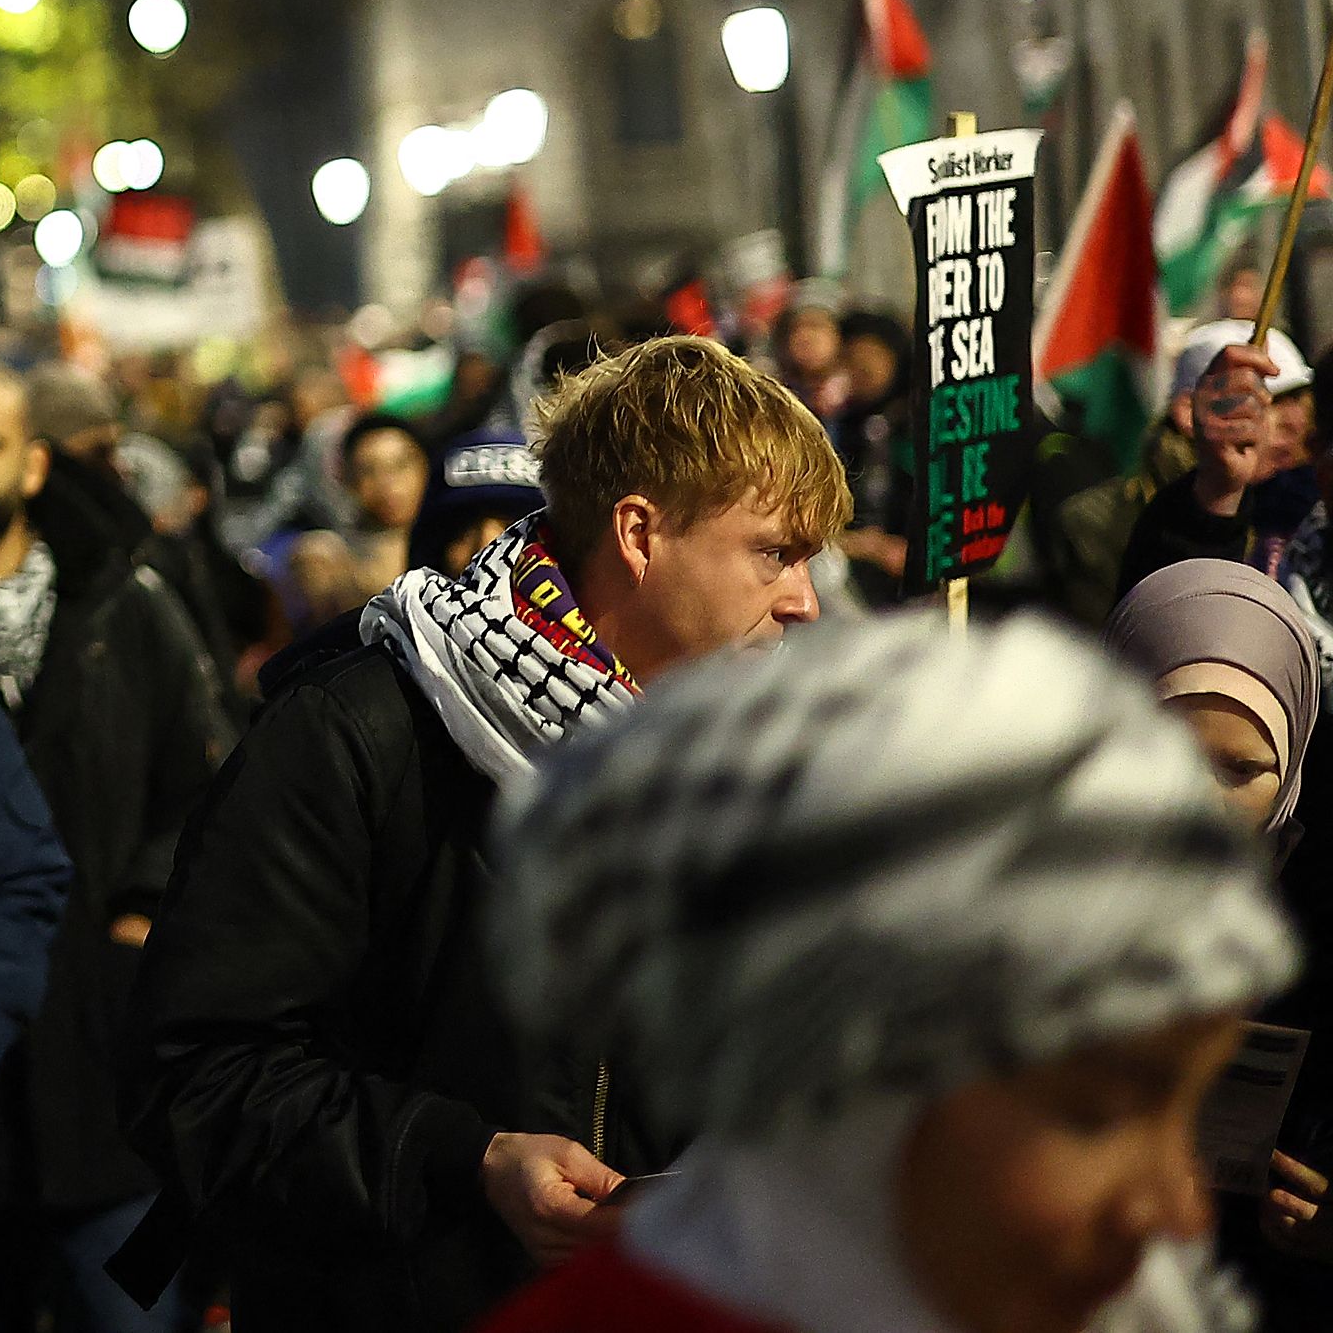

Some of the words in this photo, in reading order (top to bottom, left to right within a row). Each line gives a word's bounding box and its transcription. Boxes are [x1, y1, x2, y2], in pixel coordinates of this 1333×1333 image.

[977, 187, 1017, 250] THE
[977, 251, 1006, 312] TO
[951, 316, 995, 380] SEA
